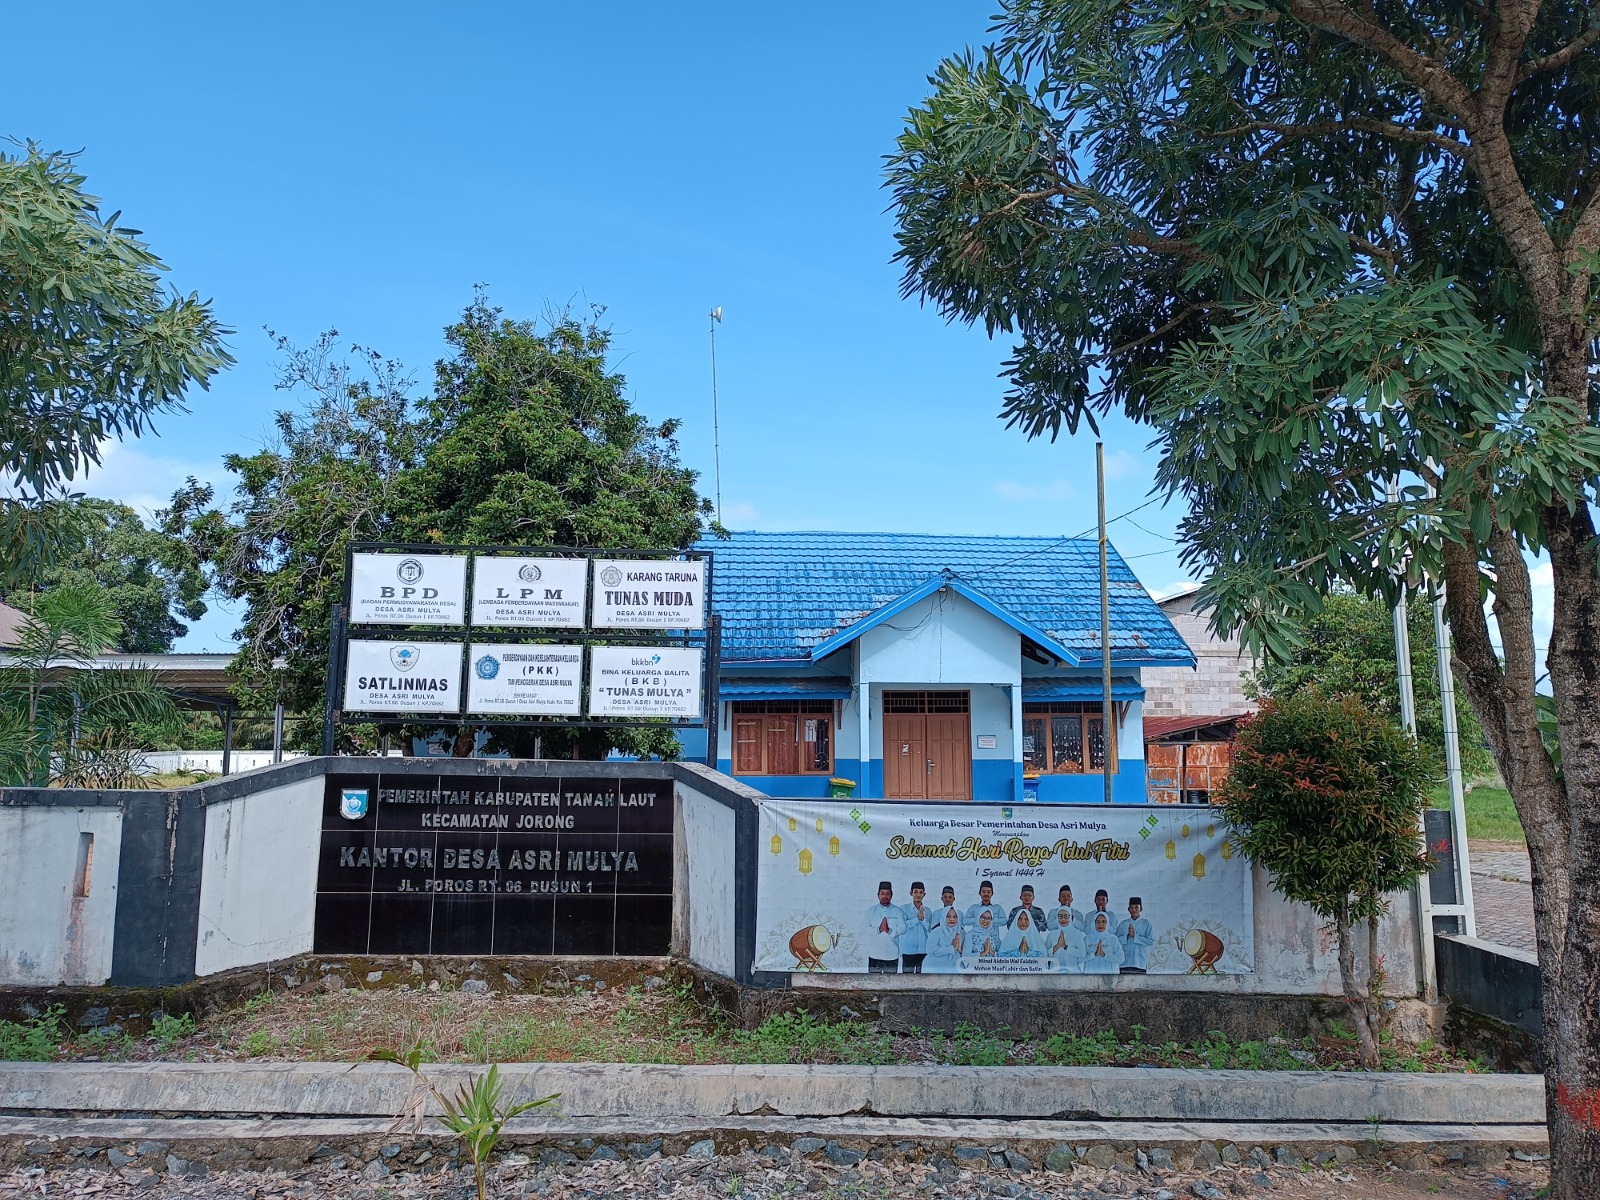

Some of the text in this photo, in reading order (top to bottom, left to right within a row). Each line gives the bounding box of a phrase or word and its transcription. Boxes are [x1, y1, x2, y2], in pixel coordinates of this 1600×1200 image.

[627, 572, 698, 582] KARANG TARUNA
[604, 591, 694, 606] TUNAS MUDA
[631, 658, 653, 666] bkkbn
[358, 676, 448, 691] SATLINMAS
[606, 687, 644, 696] TUNAS
[646, 688, 684, 697] MULYA
[378, 789, 657, 807] PEMERINTAH KABUPATEN TANAH LAUT
[421, 813, 575, 829] KECAMATAN JORONG
[909, 819, 1106, 832] Keluarga Besar Pemerintahan Desa Asri Mulya
[886, 835, 1131, 867] Selamat Hari Raya Idul Fitri
[340, 847, 639, 872] KANTOR DESA ASRI MULYA
[981, 868, 1012, 878] Syawal
[1015, 868, 1034, 877] 1444
[1035, 868, 1045, 877] H
[397, 879, 420, 892] JL.
[425, 879, 474, 892] POROS
[530, 881, 581, 893] DUSUN
[586, 881, 593, 893] 1
